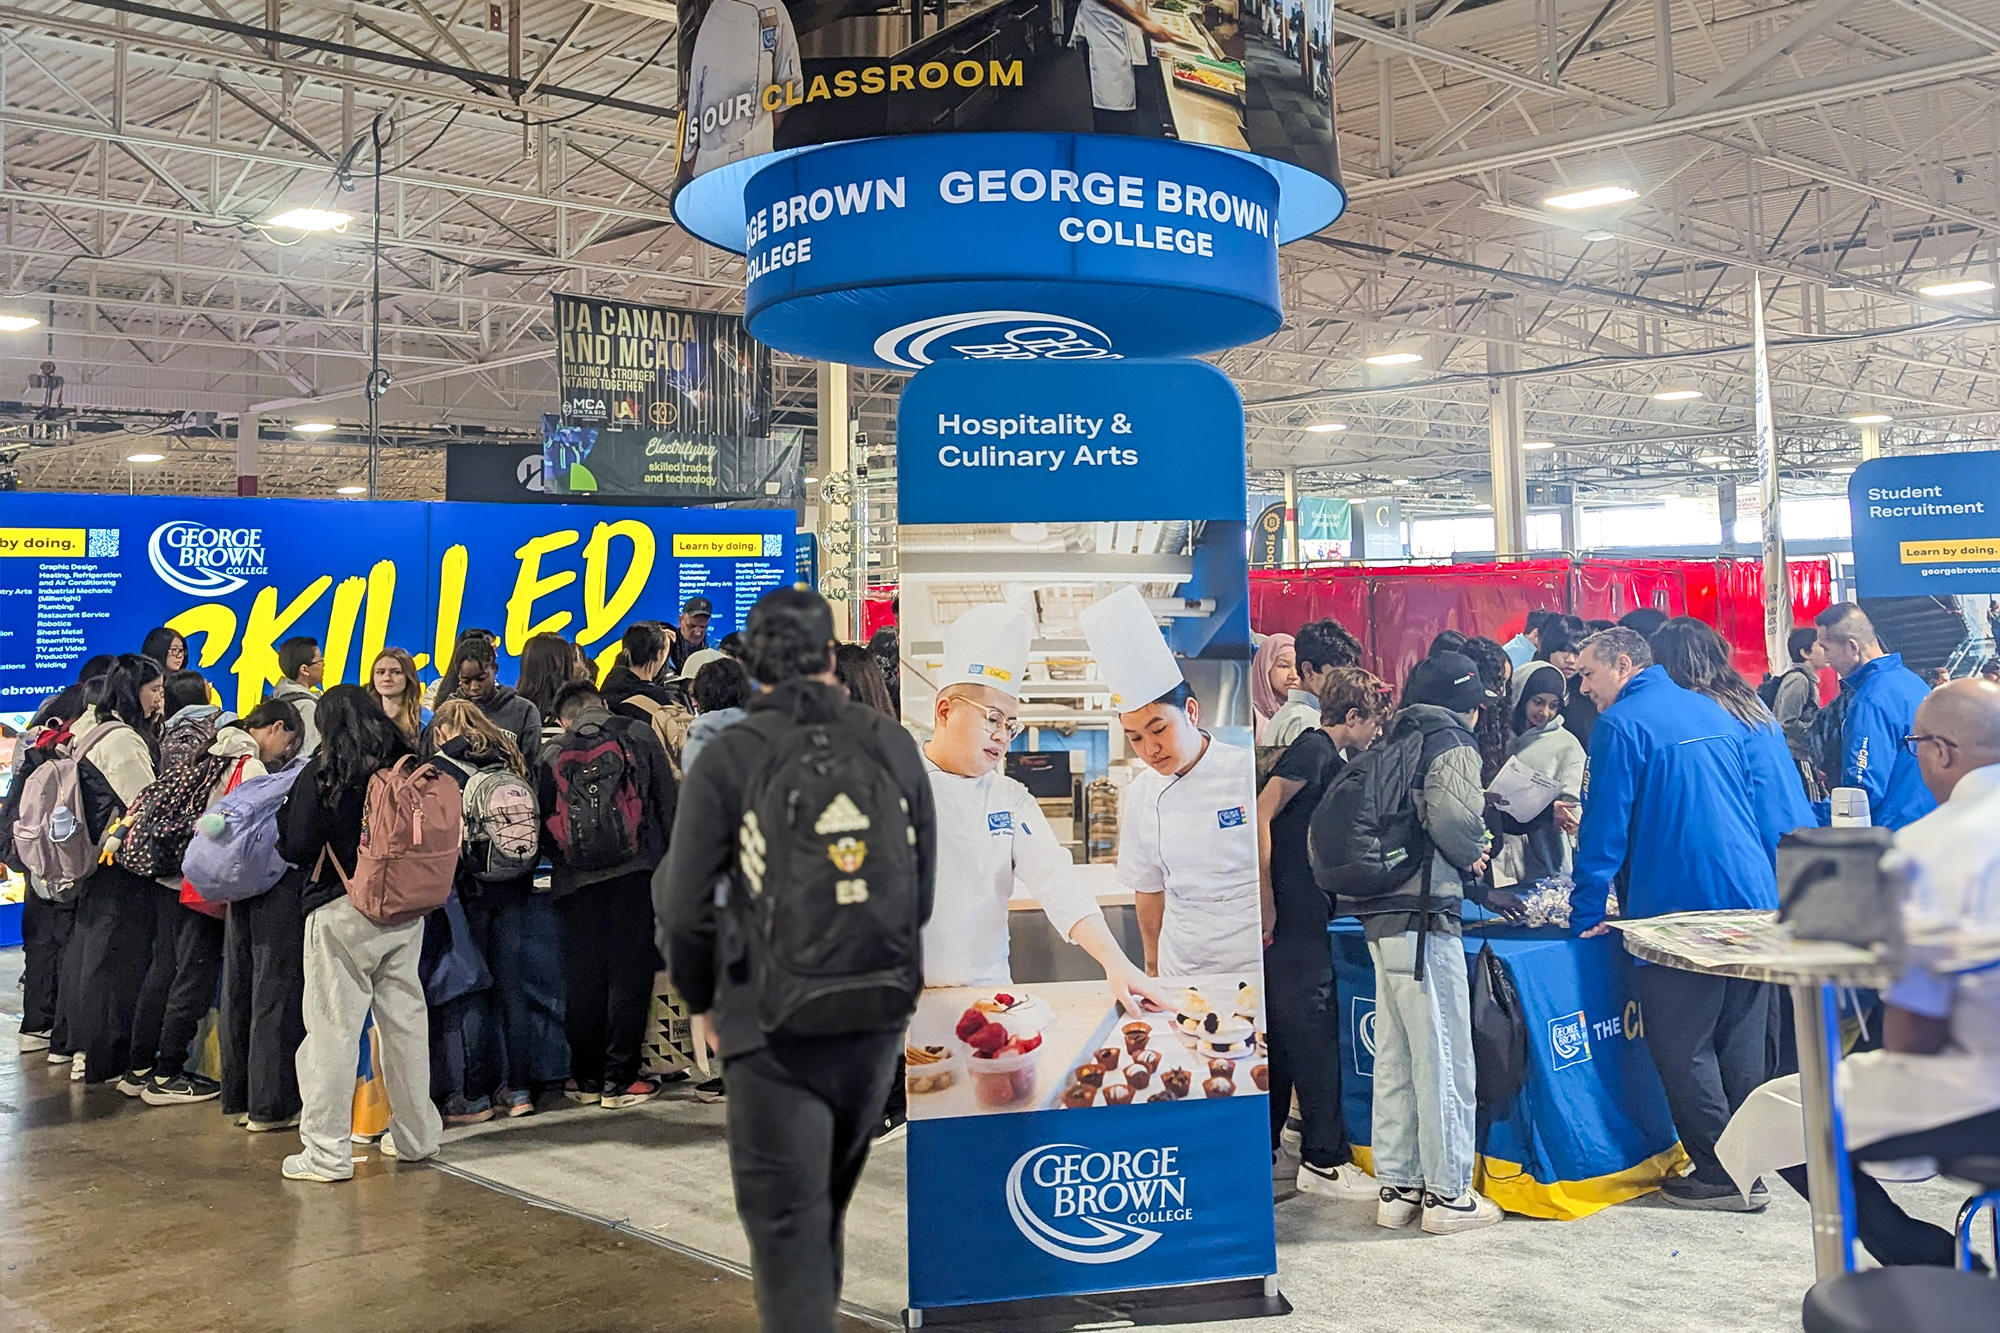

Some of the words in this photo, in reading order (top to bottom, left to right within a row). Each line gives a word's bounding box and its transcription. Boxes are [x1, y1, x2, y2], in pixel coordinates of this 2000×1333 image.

[703, 93, 753, 134] OUR
[762, 60, 1024, 112] CLASSROOM
[772, 176, 906, 233] BROWN
[939, 168, 1145, 209] GEORGE
[1158, 180, 1268, 239] BROWN
[1059, 216, 1214, 258] COLLEGE
[600, 305, 696, 344] CANADA
[563, 332, 611, 365] AND
[619, 337, 685, 372] MCAO
[564, 365, 601, 378] UILDING
[611, 368, 656, 382] STRONGER
[600, 378, 645, 393] TOGETHER
[573, 398, 607, 410] MCA
[938, 413, 1104, 440] Hospitality
[1110, 413, 1133, 435] &
[646, 437, 718, 462] Electrifying
[938, 446, 1066, 472] Culinary
[1073, 445, 1139, 467] Arts
[649, 463, 681, 472] skilled
[681, 462, 713, 473] trades
[644, 474, 664, 483] and
[666, 473, 718, 486] technology
[1868, 485, 1943, 501] Student
[1870, 501, 1985, 518] Recruitment
[0, 538, 18, 550] by
[24, 538, 76, 551] doing.
[167, 527, 262, 549] GEORGE
[679, 542, 709, 550] Learn
[711, 542, 724, 552] by
[726, 541, 757, 552] doing.
[179, 548, 266, 568] BROWN
[1906, 548, 1940, 557] Learn
[1943, 547, 1958, 557] by
[1960, 546, 1998, 556] doing.
[39, 563, 70, 571] Graphic
[71, 563, 98, 571] Design
[225, 566, 269, 575] COLLEGE
[68, 579, 117, 587] Conditioning
[1593, 1016, 1621, 1040] THE
[1624, 1000, 1644, 1040] CI
[1033, 1146, 1179, 1188] GEORGE
[1053, 1176, 1187, 1217] BROWN
[1127, 1208, 1193, 1225] COLLEGE
